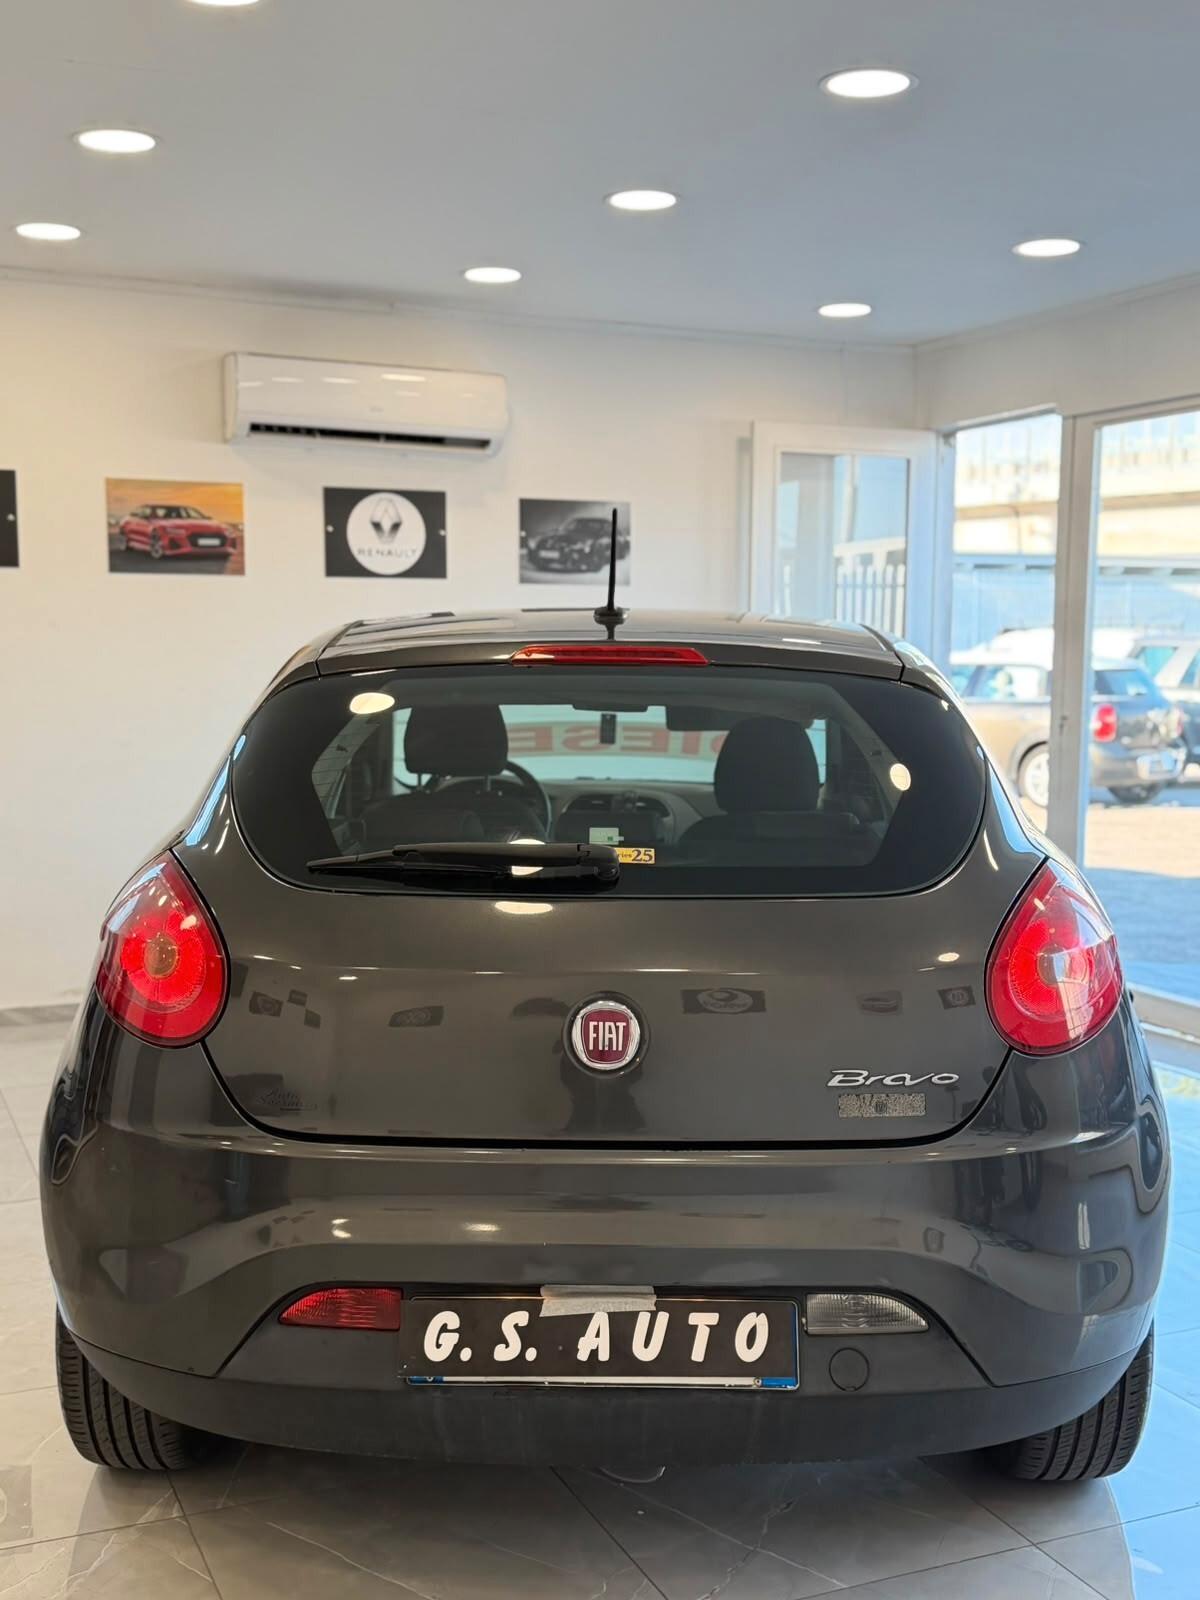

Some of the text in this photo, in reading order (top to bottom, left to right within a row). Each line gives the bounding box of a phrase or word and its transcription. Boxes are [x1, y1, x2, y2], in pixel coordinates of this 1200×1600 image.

[358, 547, 417, 558] RENAULT
[631, 849, 653, 862] 25
[588, 1021, 627, 1051] FIAT
[827, 1069, 959, 1086] Bravo
[576, 1310, 769, 1363] AUTO
